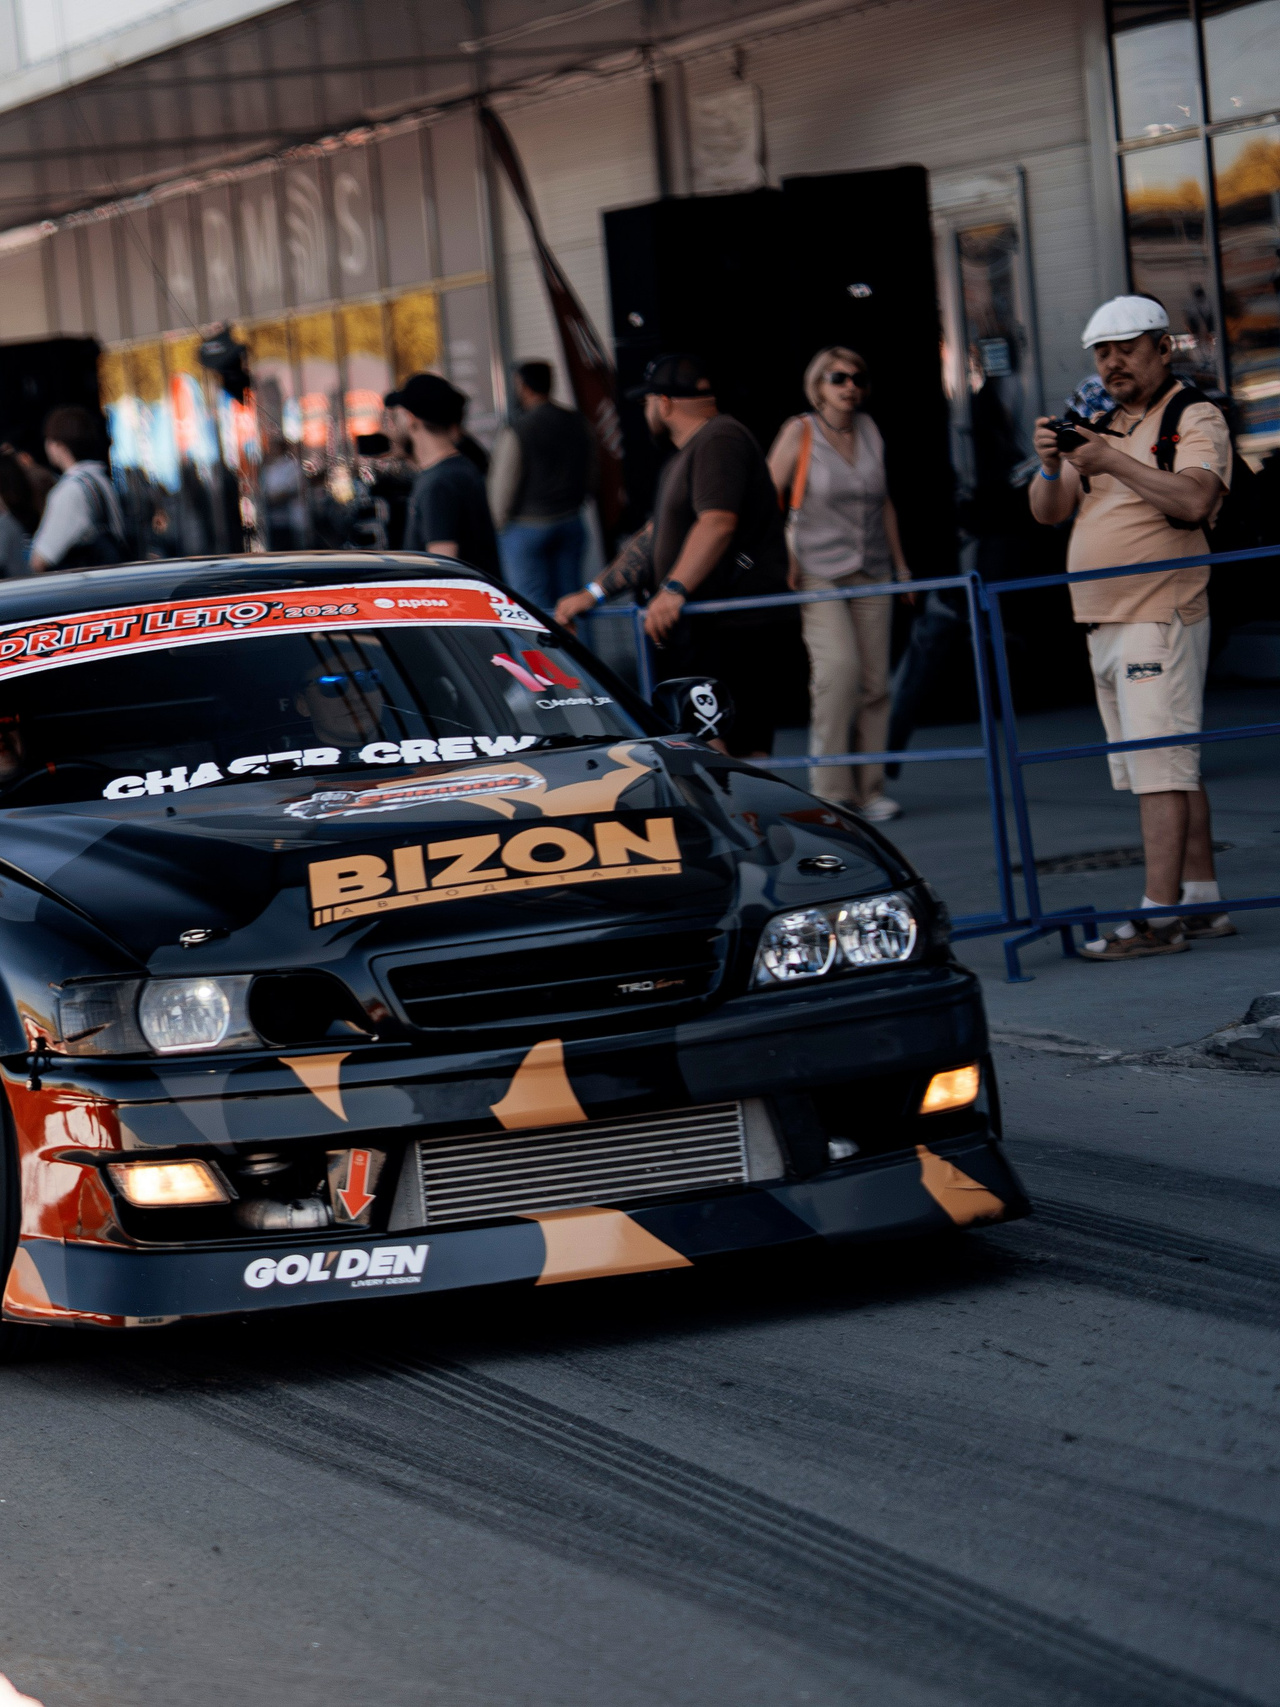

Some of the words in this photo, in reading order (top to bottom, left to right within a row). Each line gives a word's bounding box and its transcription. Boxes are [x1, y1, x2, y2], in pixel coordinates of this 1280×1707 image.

[142, 601, 271, 634] LETO
[284, 603, 359, 619] 2026
[359, 735, 538, 764] CREW
[308, 817, 682, 909] BIZON
[340, 864, 674, 917] АВТОДЕТАЛЬ
[350, 1278, 385, 1288] LIVERY
[385, 1276, 422, 1286] DESIGN
